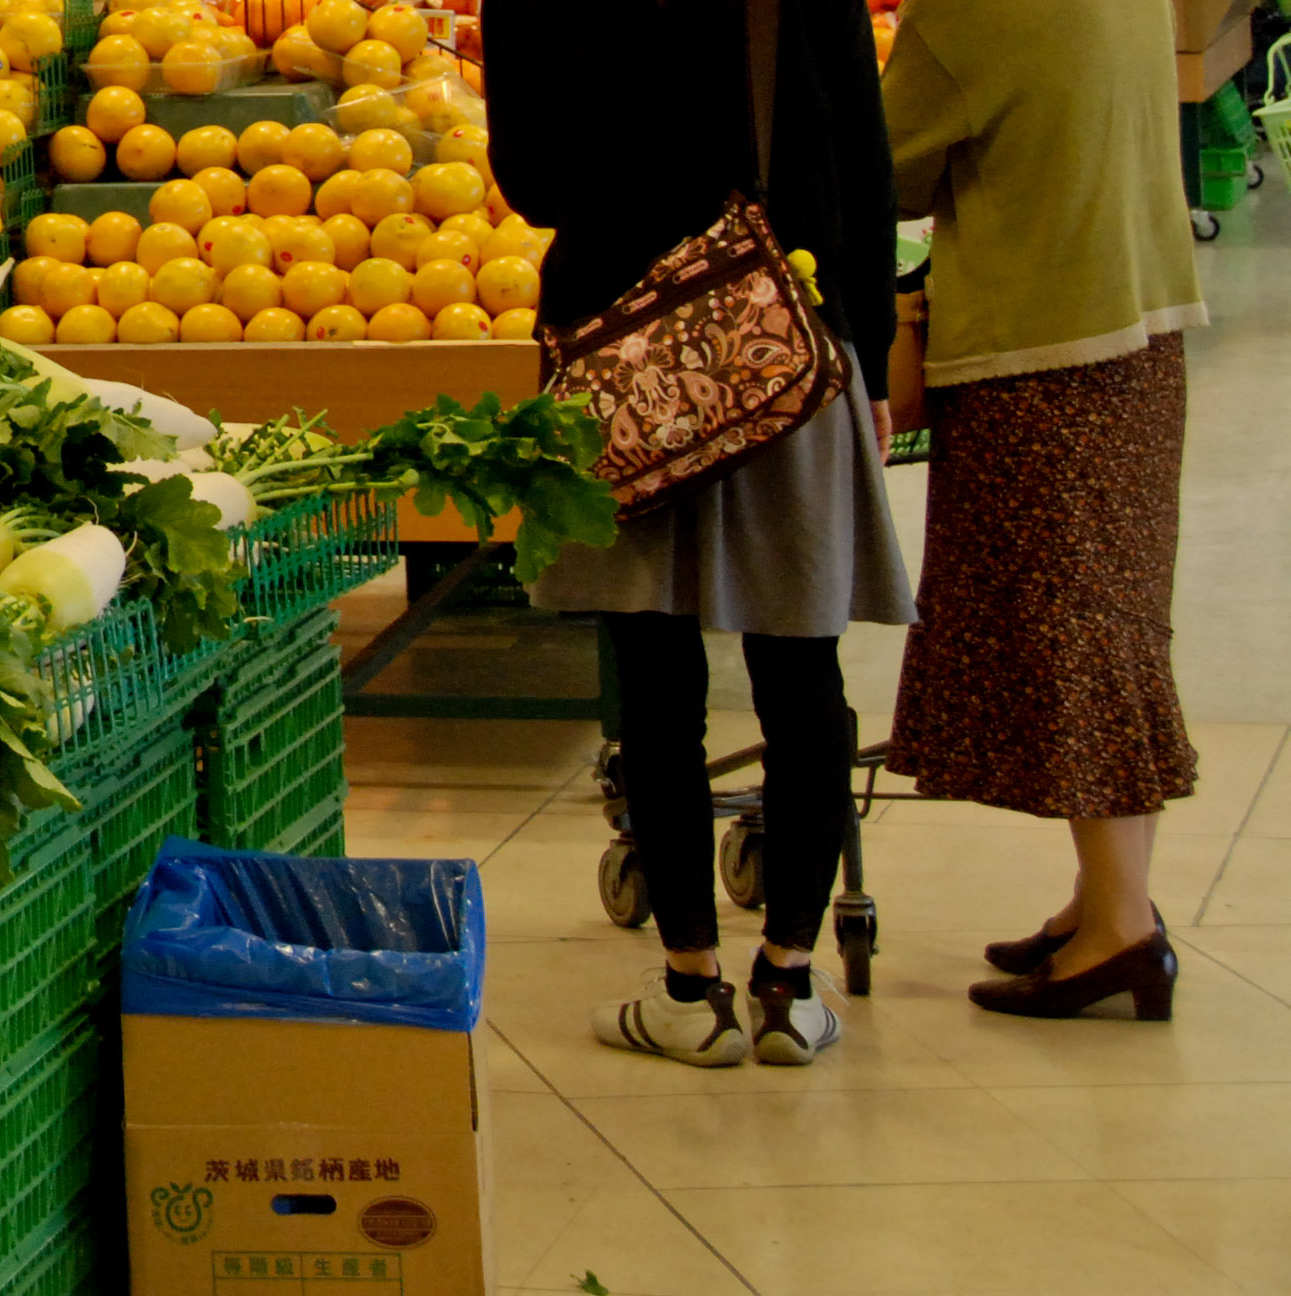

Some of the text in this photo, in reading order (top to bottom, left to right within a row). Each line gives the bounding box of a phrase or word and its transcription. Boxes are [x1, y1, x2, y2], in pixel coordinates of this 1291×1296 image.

[205, 1158, 401, 1182] 茨城県銘柄産地
